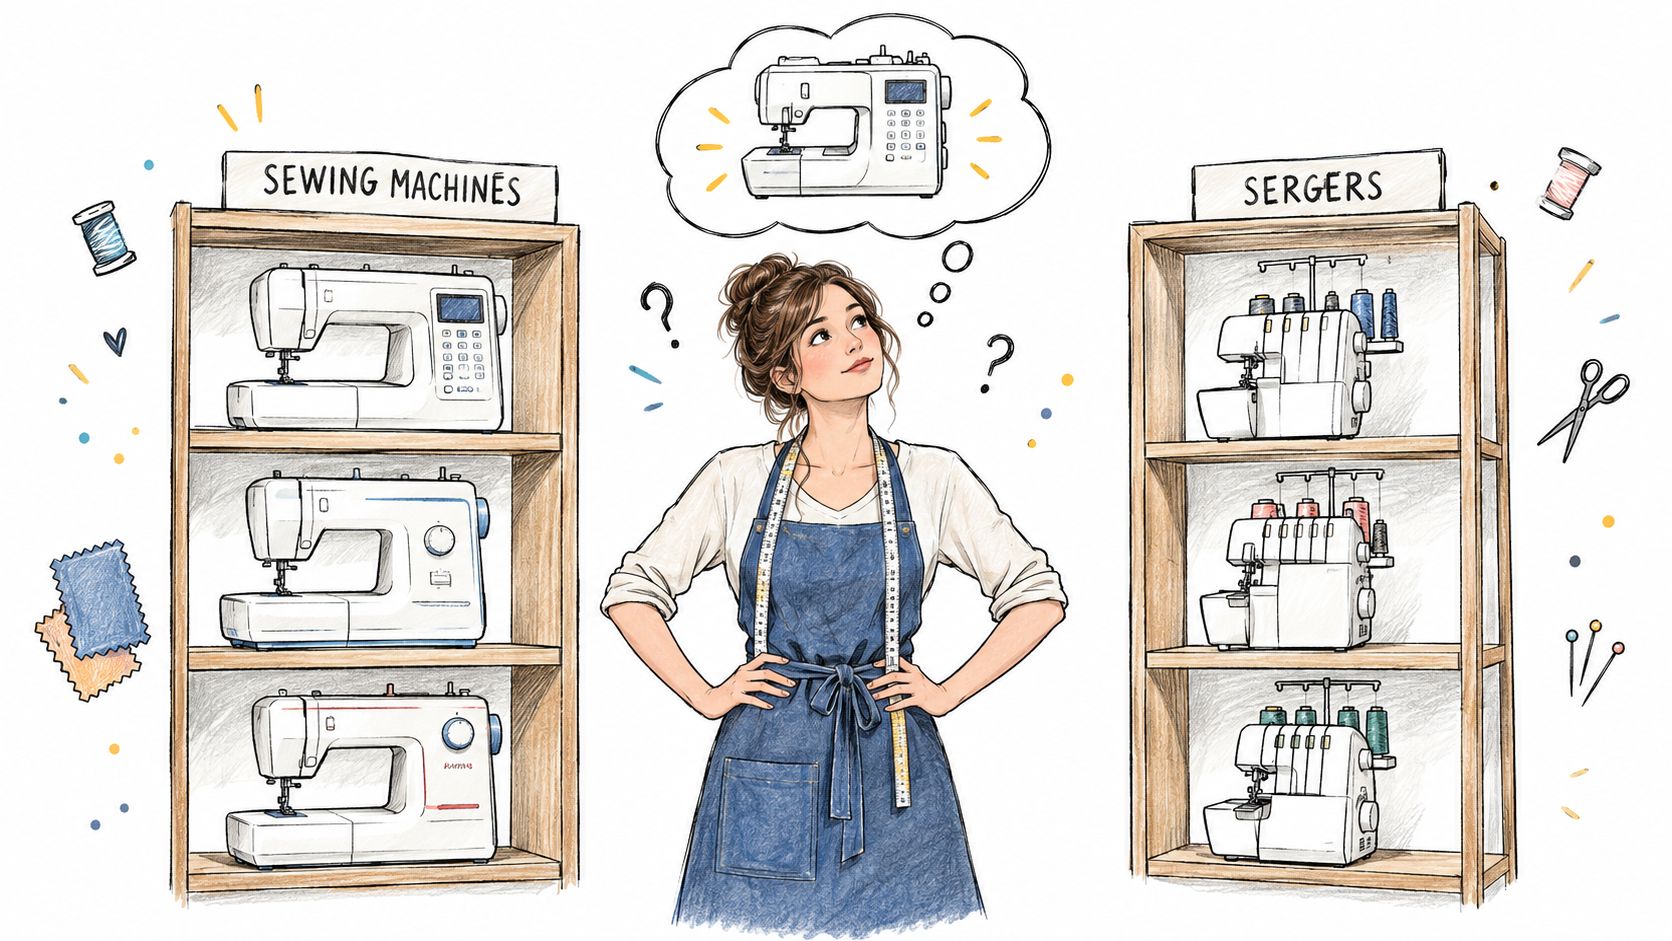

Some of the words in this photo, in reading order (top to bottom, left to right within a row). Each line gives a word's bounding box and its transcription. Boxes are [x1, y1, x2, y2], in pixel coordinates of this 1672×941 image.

[263, 163, 378, 196] SEWING
[390, 168, 521, 207] MACHINES
[1244, 170, 1383, 206] SERGERS
